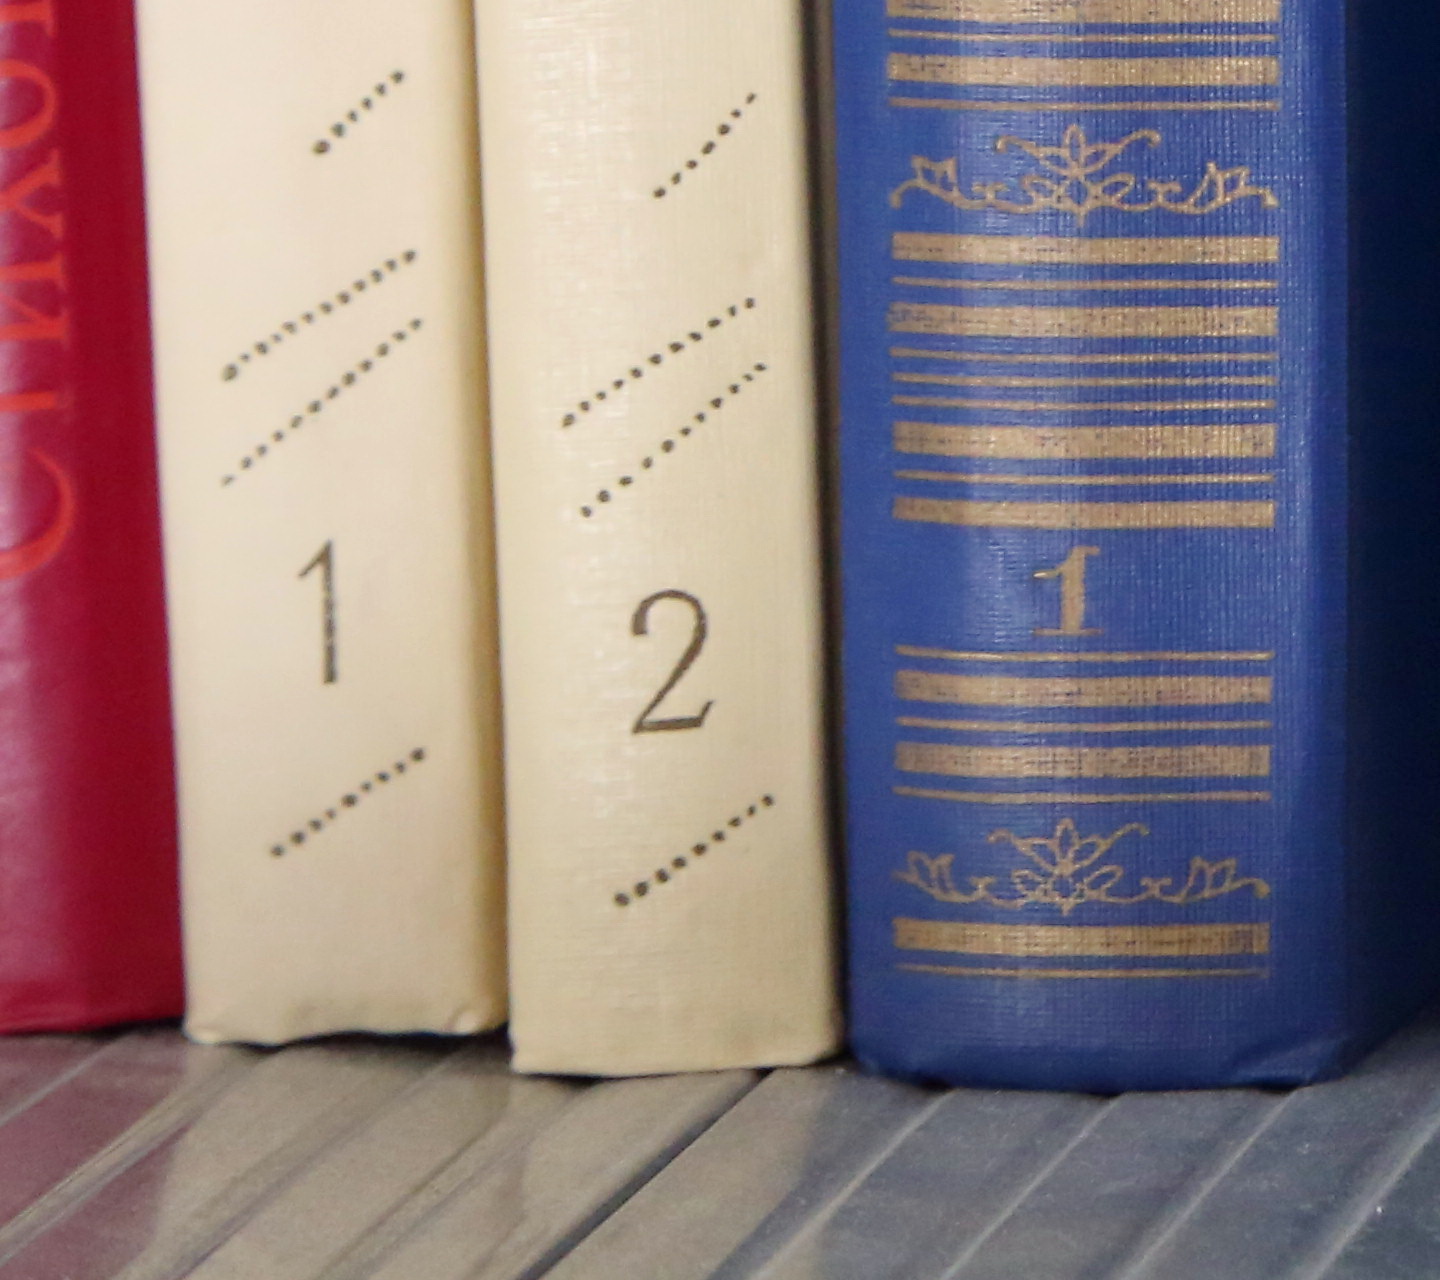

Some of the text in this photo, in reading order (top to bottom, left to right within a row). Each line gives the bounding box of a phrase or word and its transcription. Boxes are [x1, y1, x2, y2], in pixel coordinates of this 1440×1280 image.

[298, 539, 339, 685] 1
[630, 588, 714, 736] 2
[1031, 544, 1105, 638] 1
